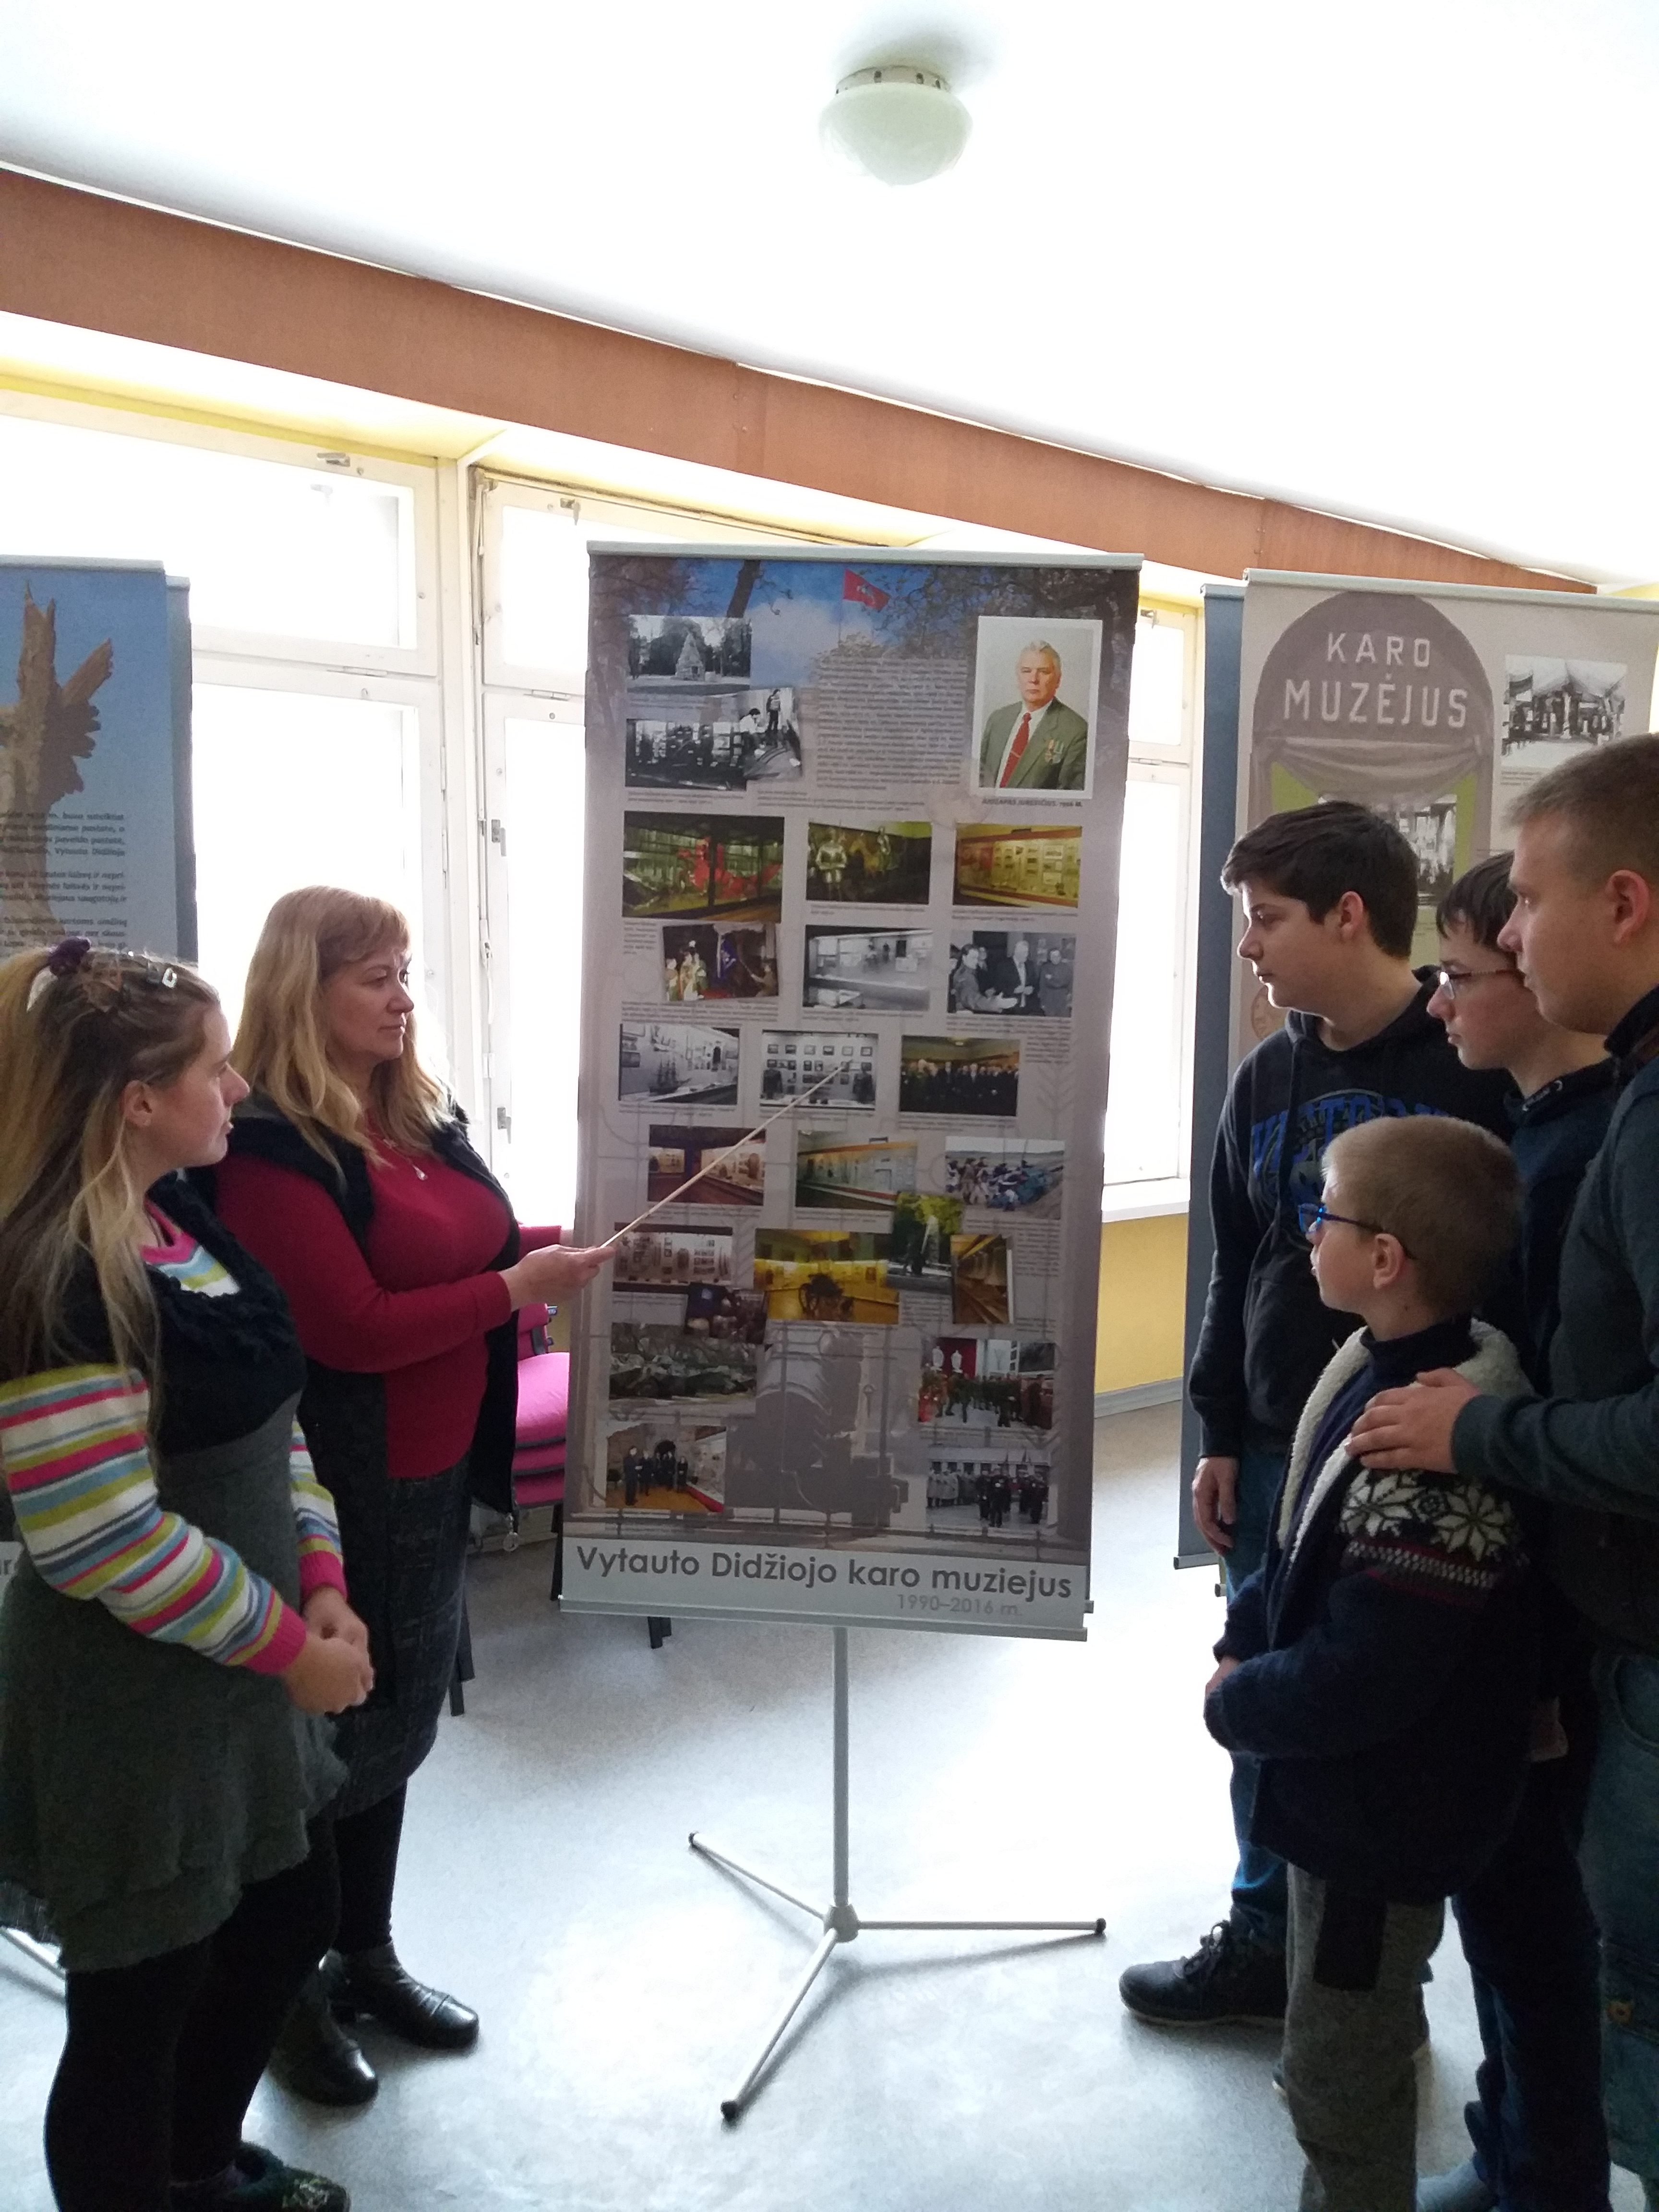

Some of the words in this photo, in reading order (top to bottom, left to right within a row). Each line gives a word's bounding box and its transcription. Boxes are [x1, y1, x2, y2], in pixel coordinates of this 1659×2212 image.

[1327, 632, 1431, 667] KARO
[1283, 673, 1468, 729] MUZĖJUS
[577, 1546, 699, 1577] Vytauto
[712, 1551, 837, 1589] Didžiojo
[849, 1559, 920, 1587] karo
[932, 1567, 1071, 1602] muziejus
